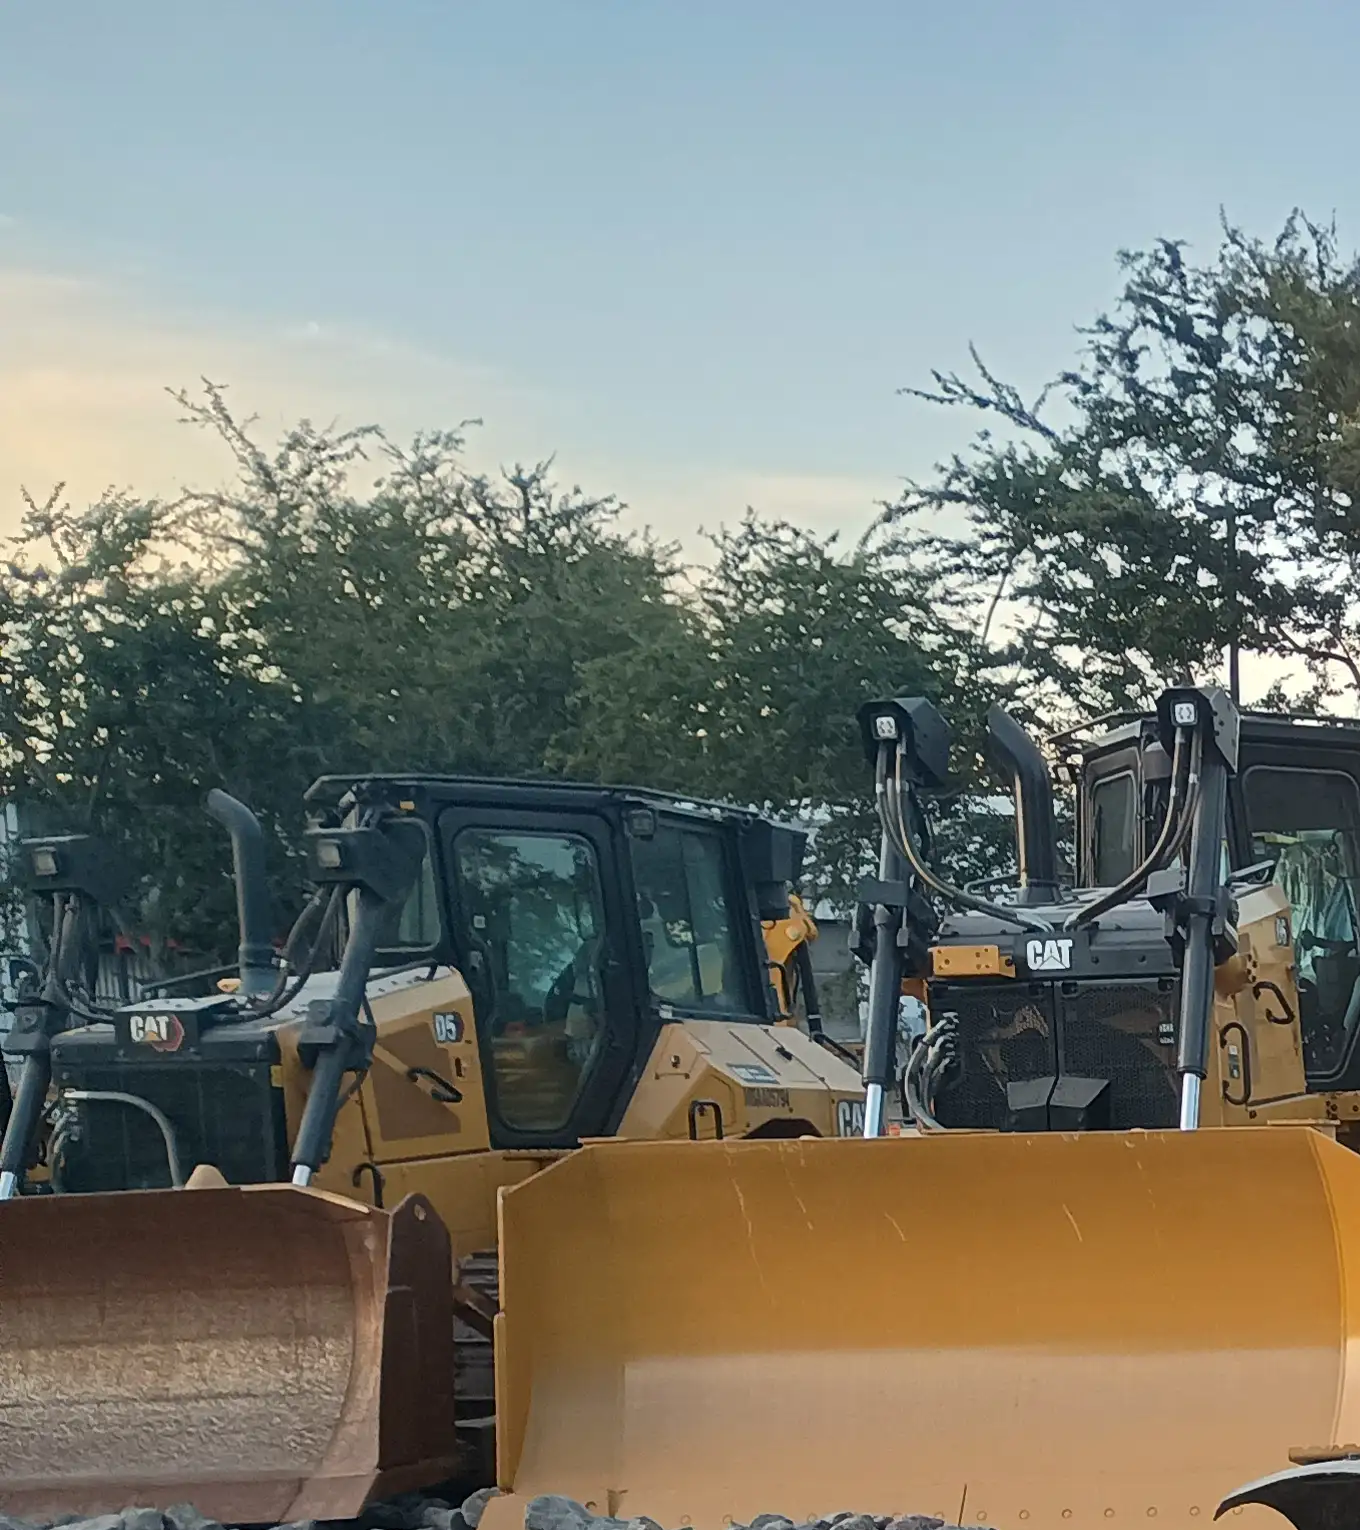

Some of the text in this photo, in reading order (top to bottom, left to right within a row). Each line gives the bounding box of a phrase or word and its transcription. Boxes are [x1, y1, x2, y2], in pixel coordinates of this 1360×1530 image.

[1026, 939, 1073, 970] CAT
[130, 1015, 169, 1042] CAT
[435, 1014, 457, 1041] D5
[838, 1101, 866, 1137] CA
